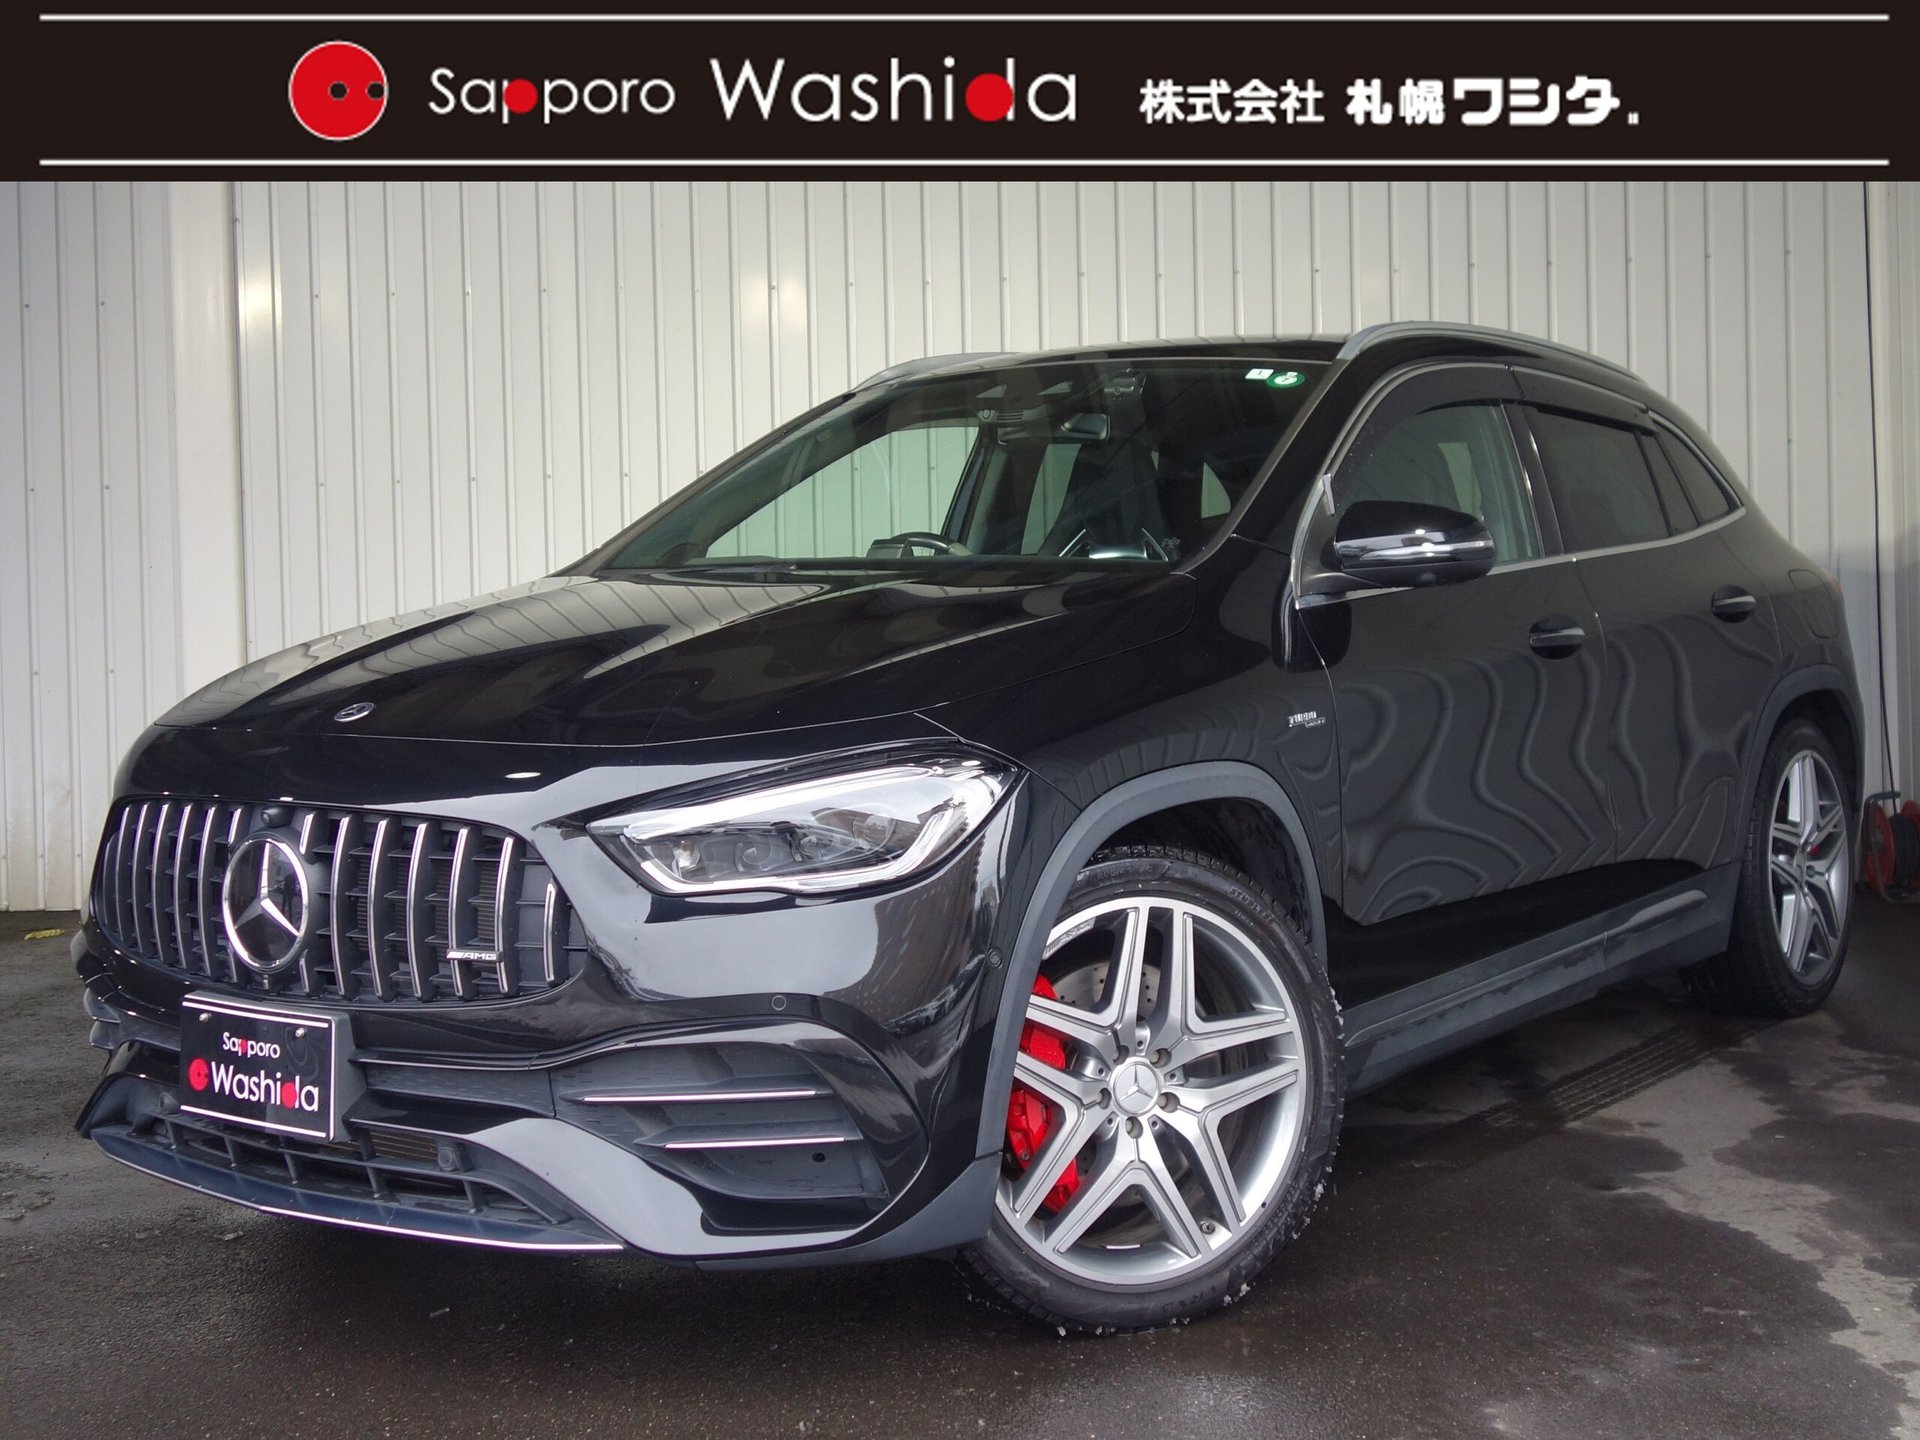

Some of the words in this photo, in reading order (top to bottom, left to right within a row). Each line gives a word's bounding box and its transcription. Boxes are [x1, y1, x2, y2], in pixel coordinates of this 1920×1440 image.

[460, 951, 497, 960] AMG
[222, 1031, 281, 1058] Sapporo
[211, 1061, 320, 1112] Washida
